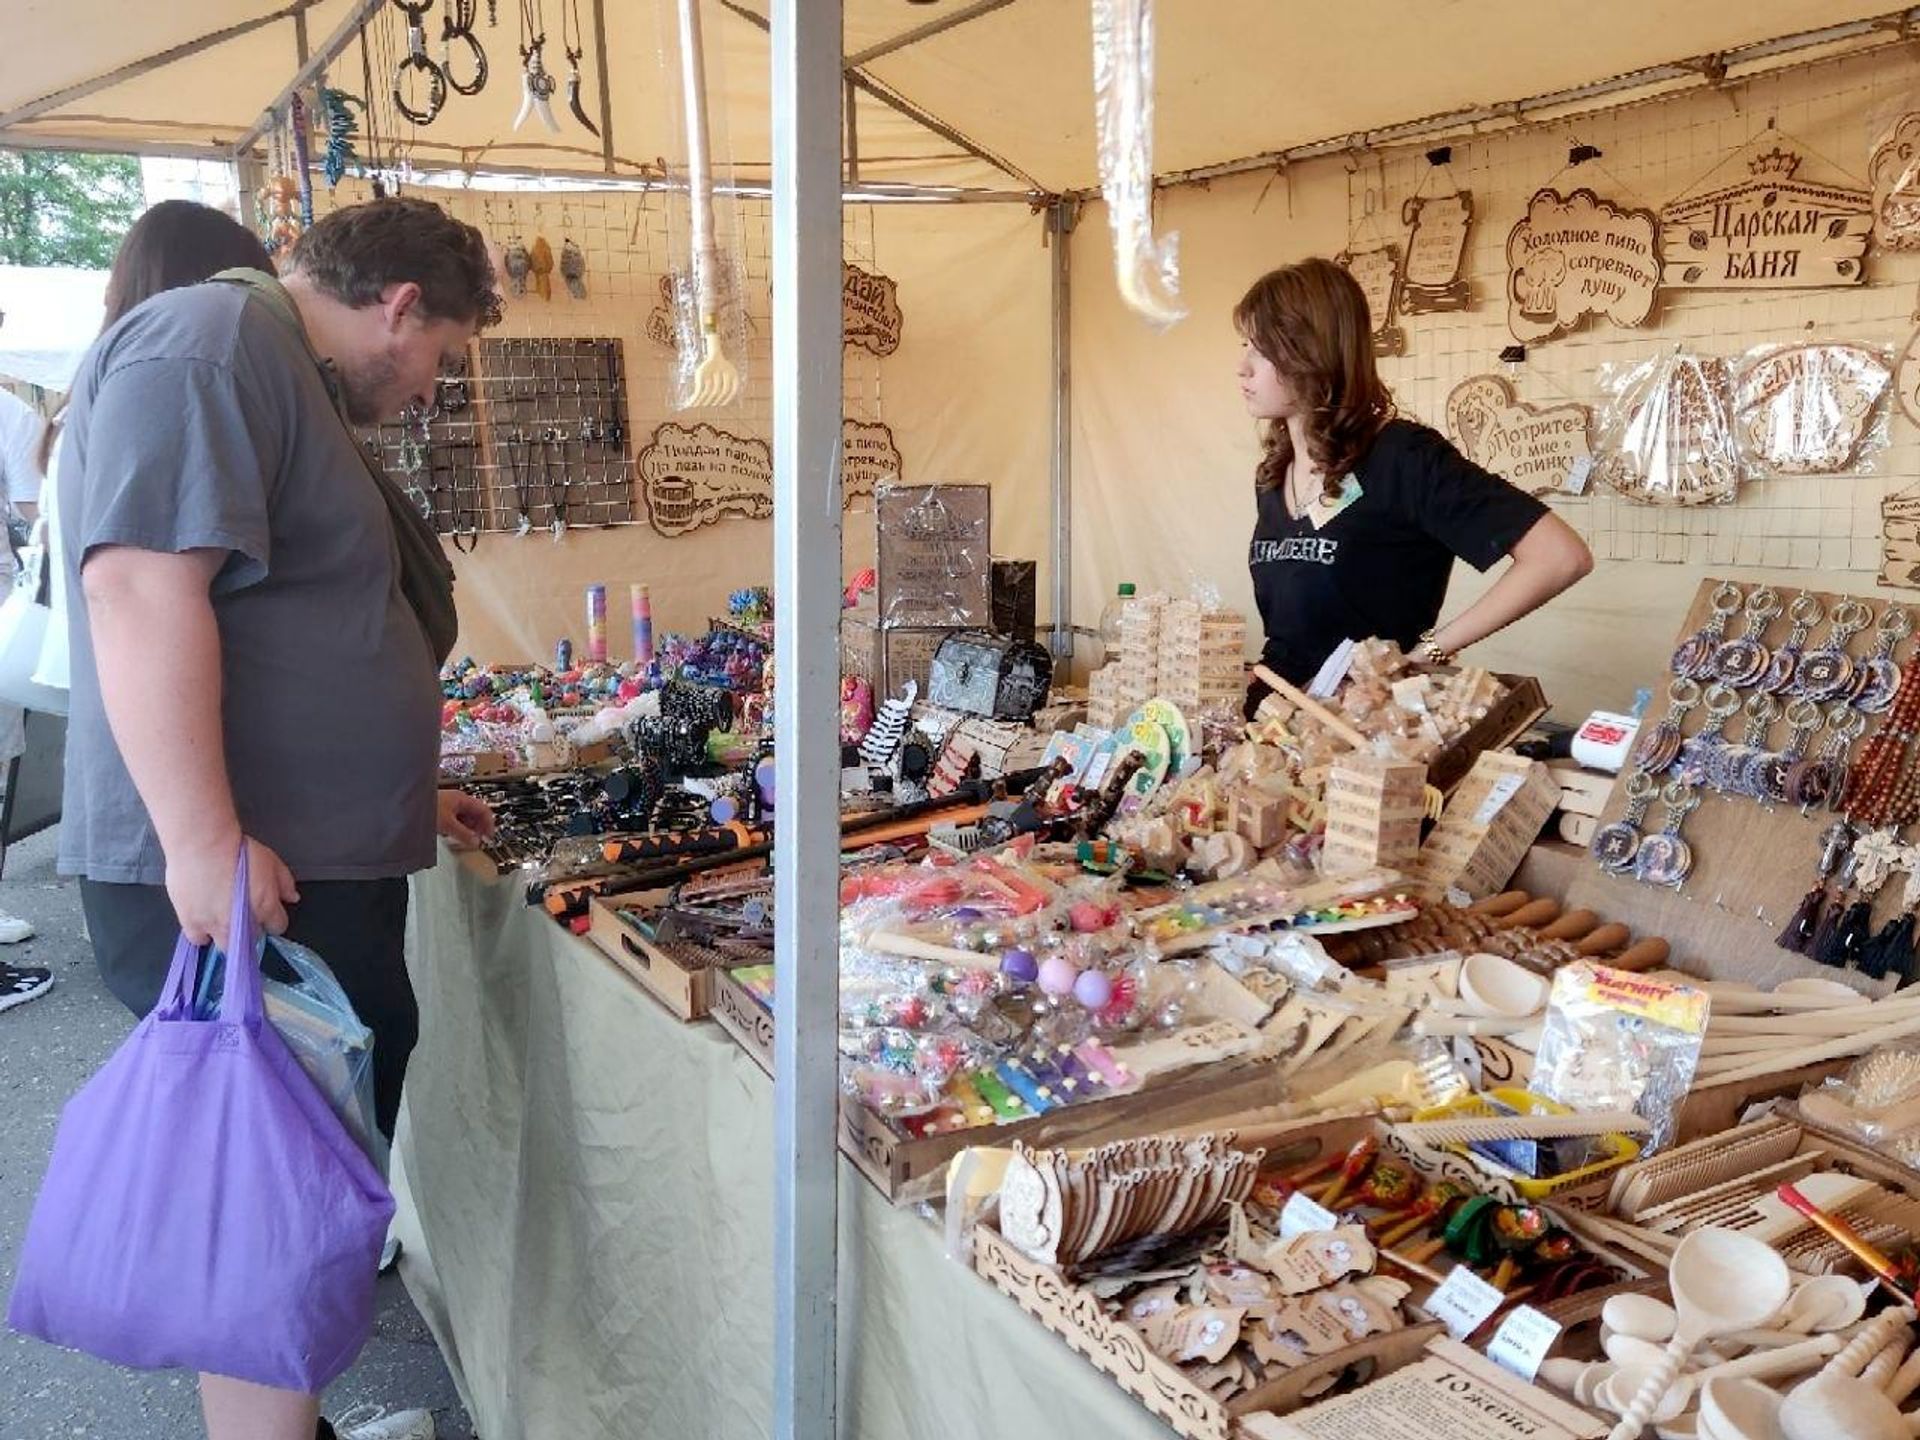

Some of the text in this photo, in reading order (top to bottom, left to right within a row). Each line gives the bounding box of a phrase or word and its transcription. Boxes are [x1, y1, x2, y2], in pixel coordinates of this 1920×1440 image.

[1710, 203, 1820, 248] Царская
[1521, 229, 1647, 256] Холодное пиво
[1568, 254, 1654, 288] согревает
[1724, 250, 1801, 280] БАНЯ
[1580, 277, 1627, 304] душу
[1494, 416, 1574, 451] Потрите
[1527, 439, 1559, 458] мне
